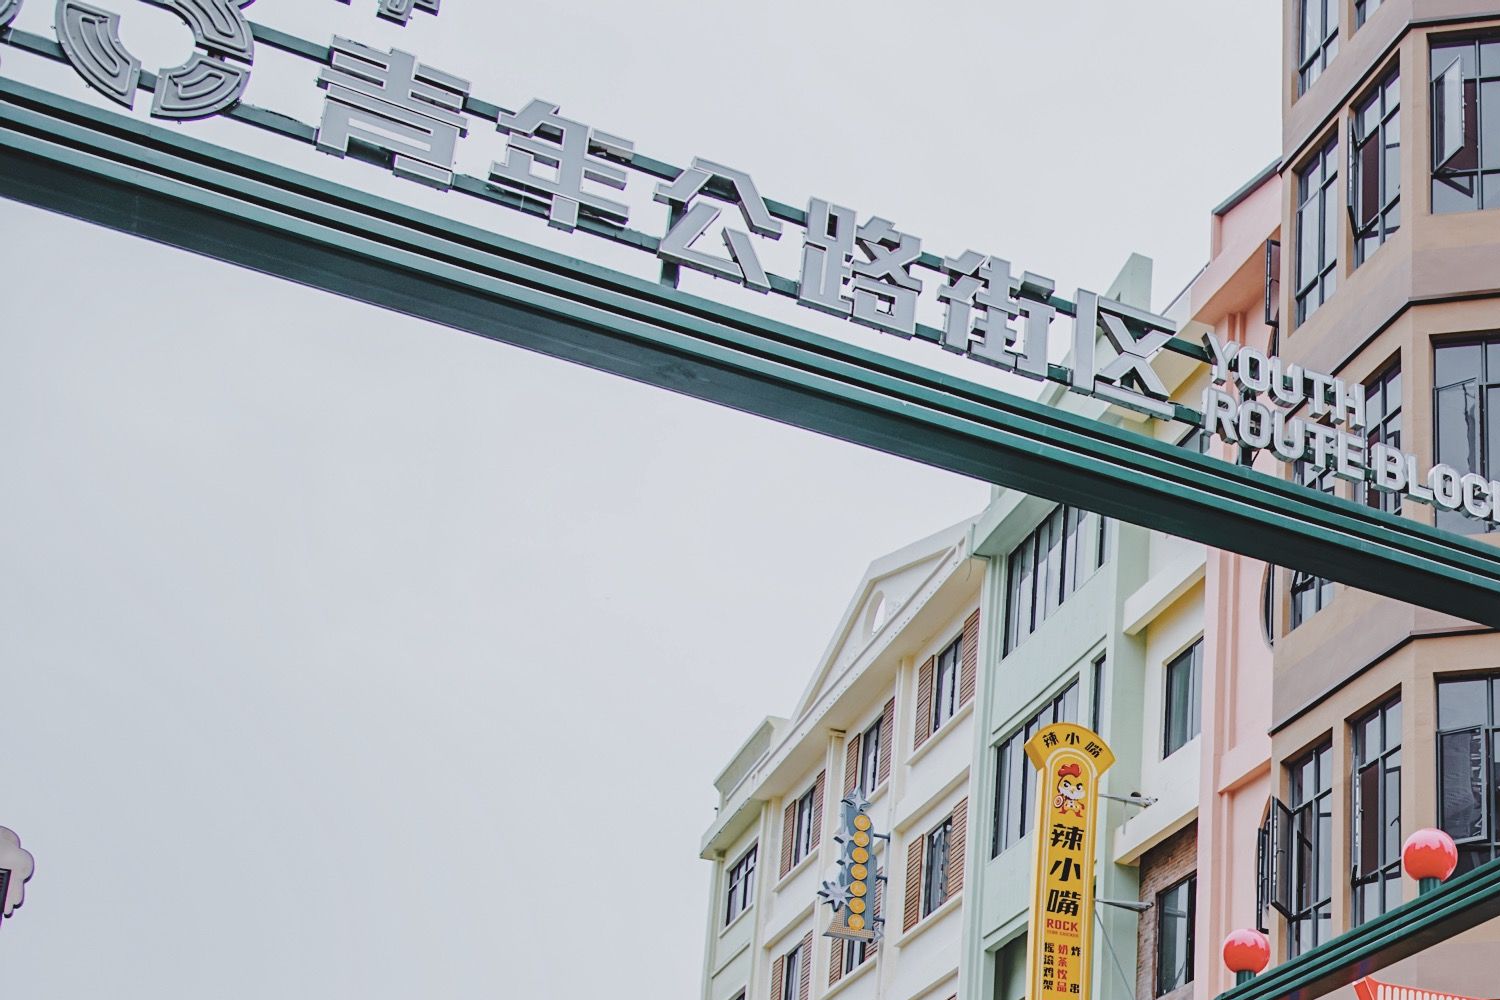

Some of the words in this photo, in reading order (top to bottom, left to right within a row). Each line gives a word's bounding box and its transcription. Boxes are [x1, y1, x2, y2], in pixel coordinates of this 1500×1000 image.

[315, 34, 1177, 421] 青年公路街区
[1201, 332, 1365, 430] YOUTH
[1201, 387, 1365, 484] ROUTE
[1043, 732, 1103, 759] 辣小嘴
[1046, 824, 1084, 916] 辣小嘴
[1047, 919, 1078, 932] ROCK
